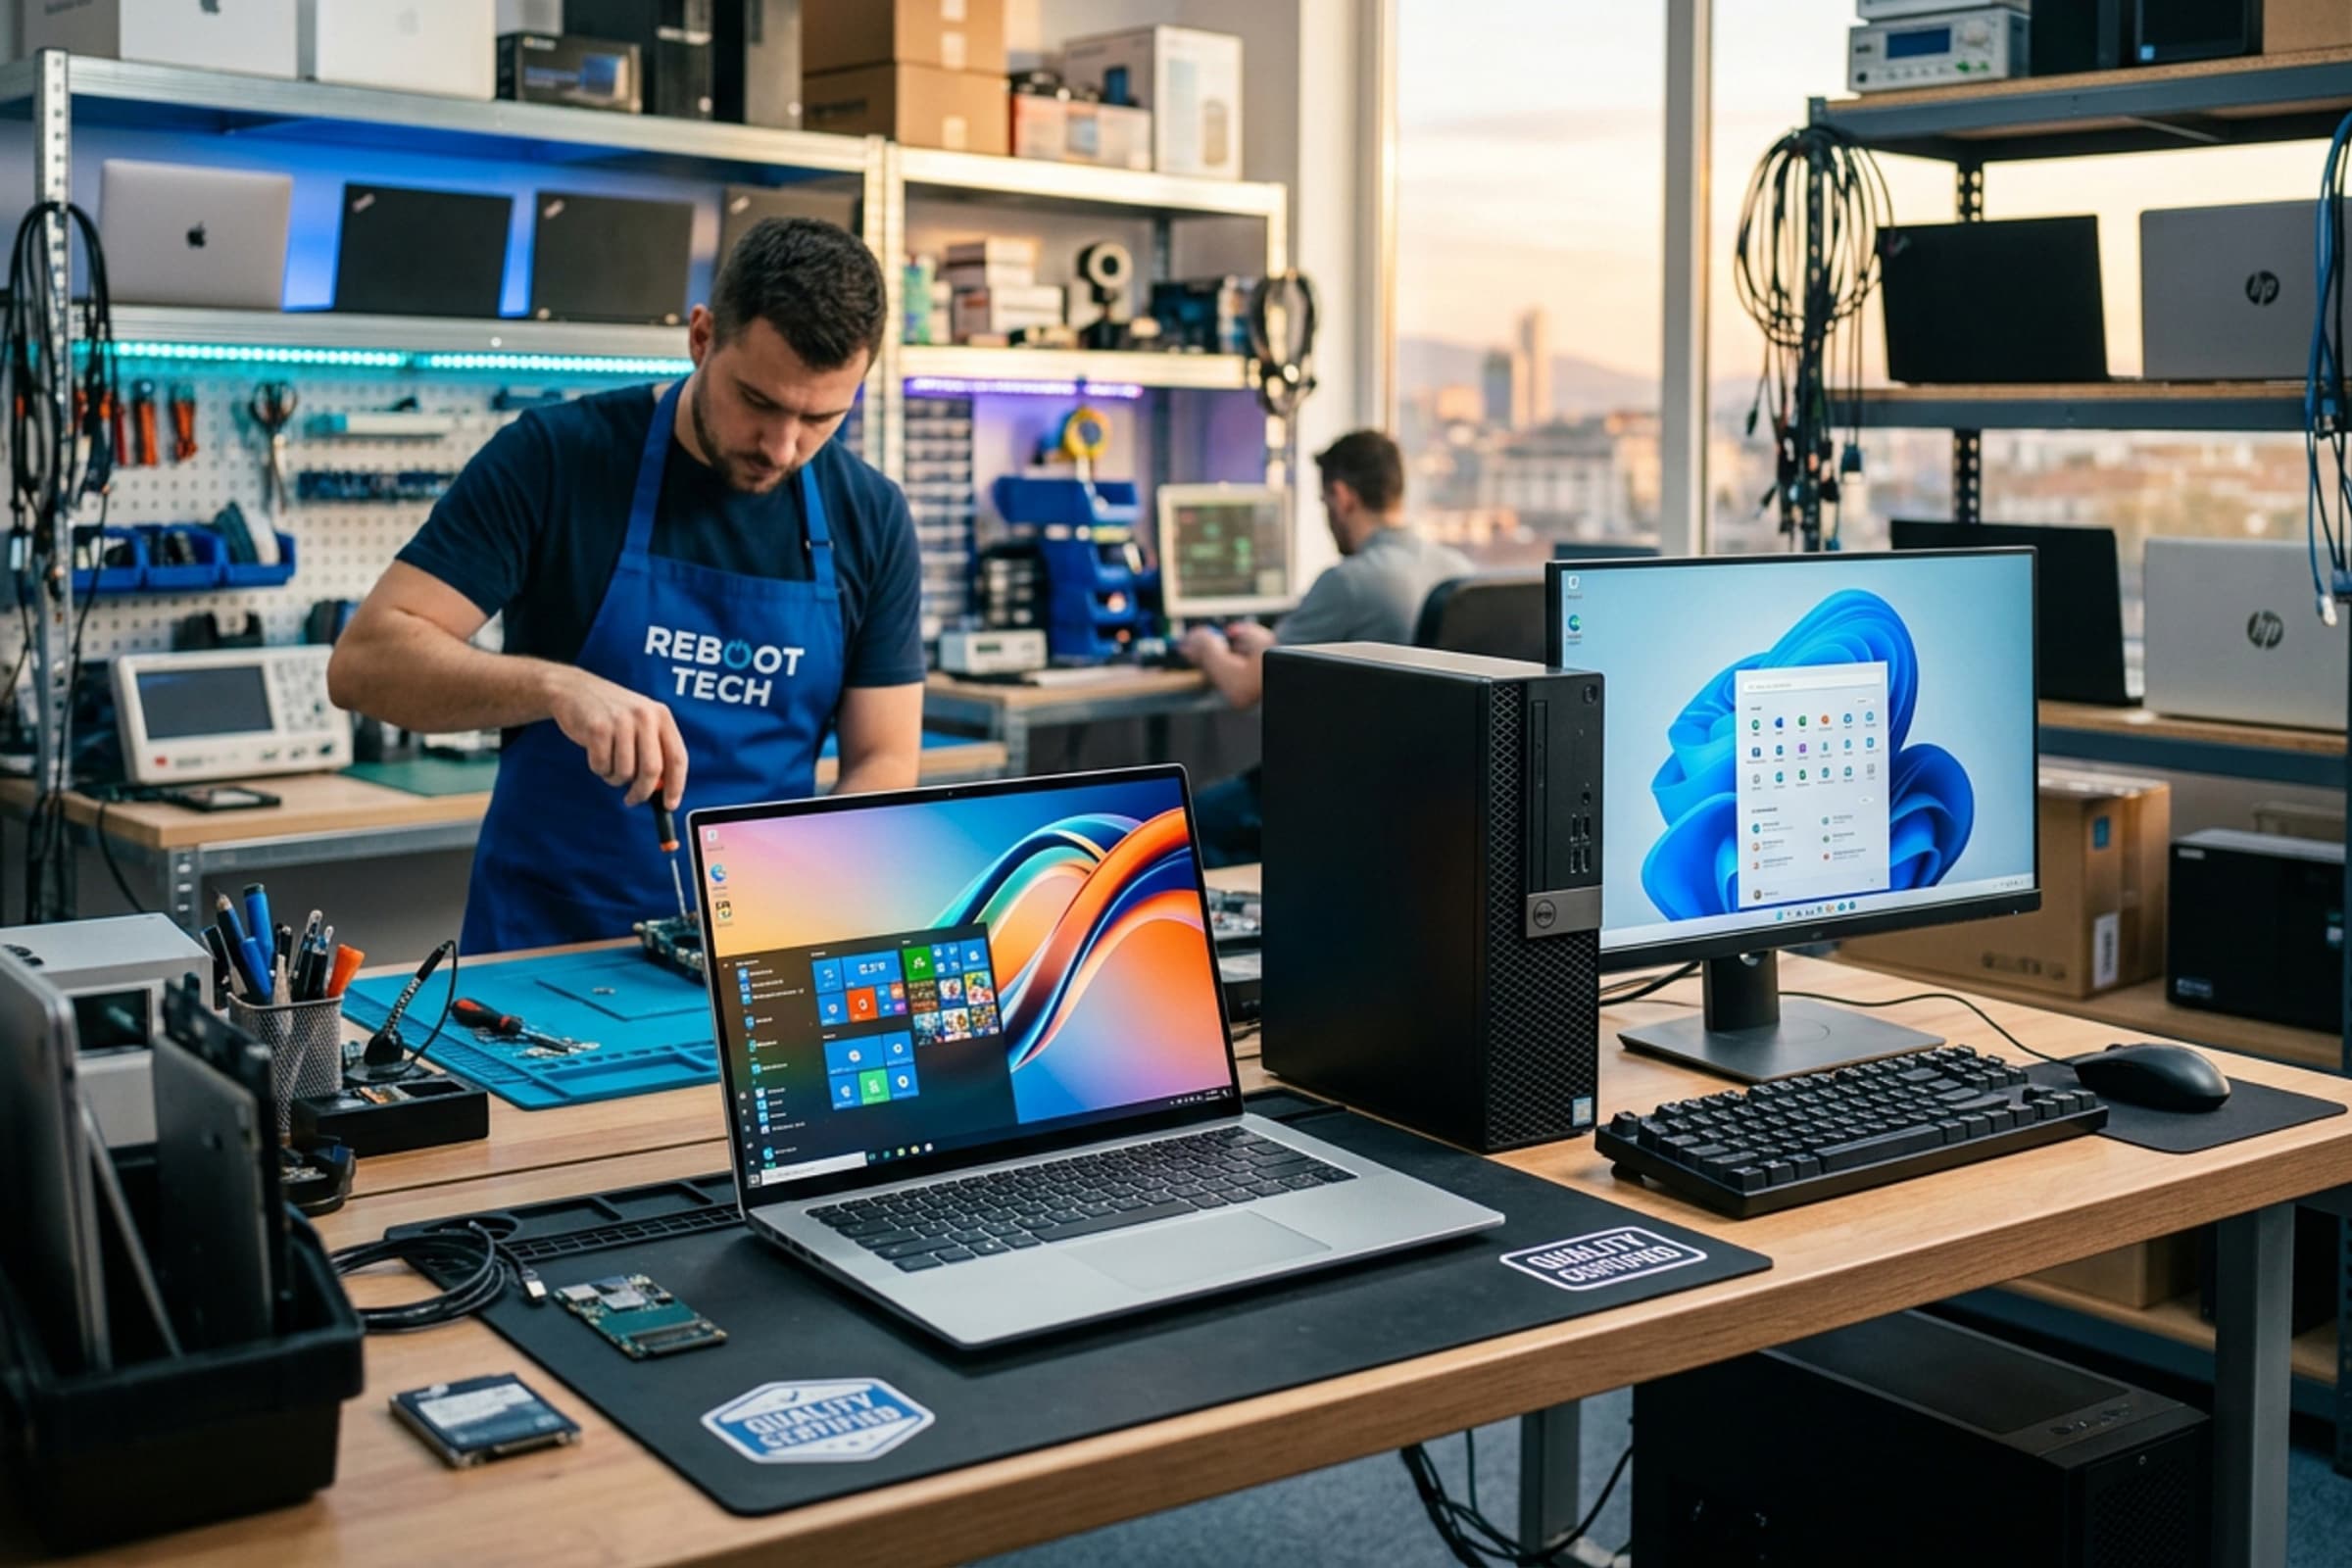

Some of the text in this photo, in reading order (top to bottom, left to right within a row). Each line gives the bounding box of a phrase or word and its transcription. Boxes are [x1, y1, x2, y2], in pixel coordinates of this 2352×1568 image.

[644, 625, 805, 676] REBOOT
[2247, 611, 2282, 650] hp
[671, 666, 772, 708] TECH
[743, 1391, 874, 1435] QUALITY
